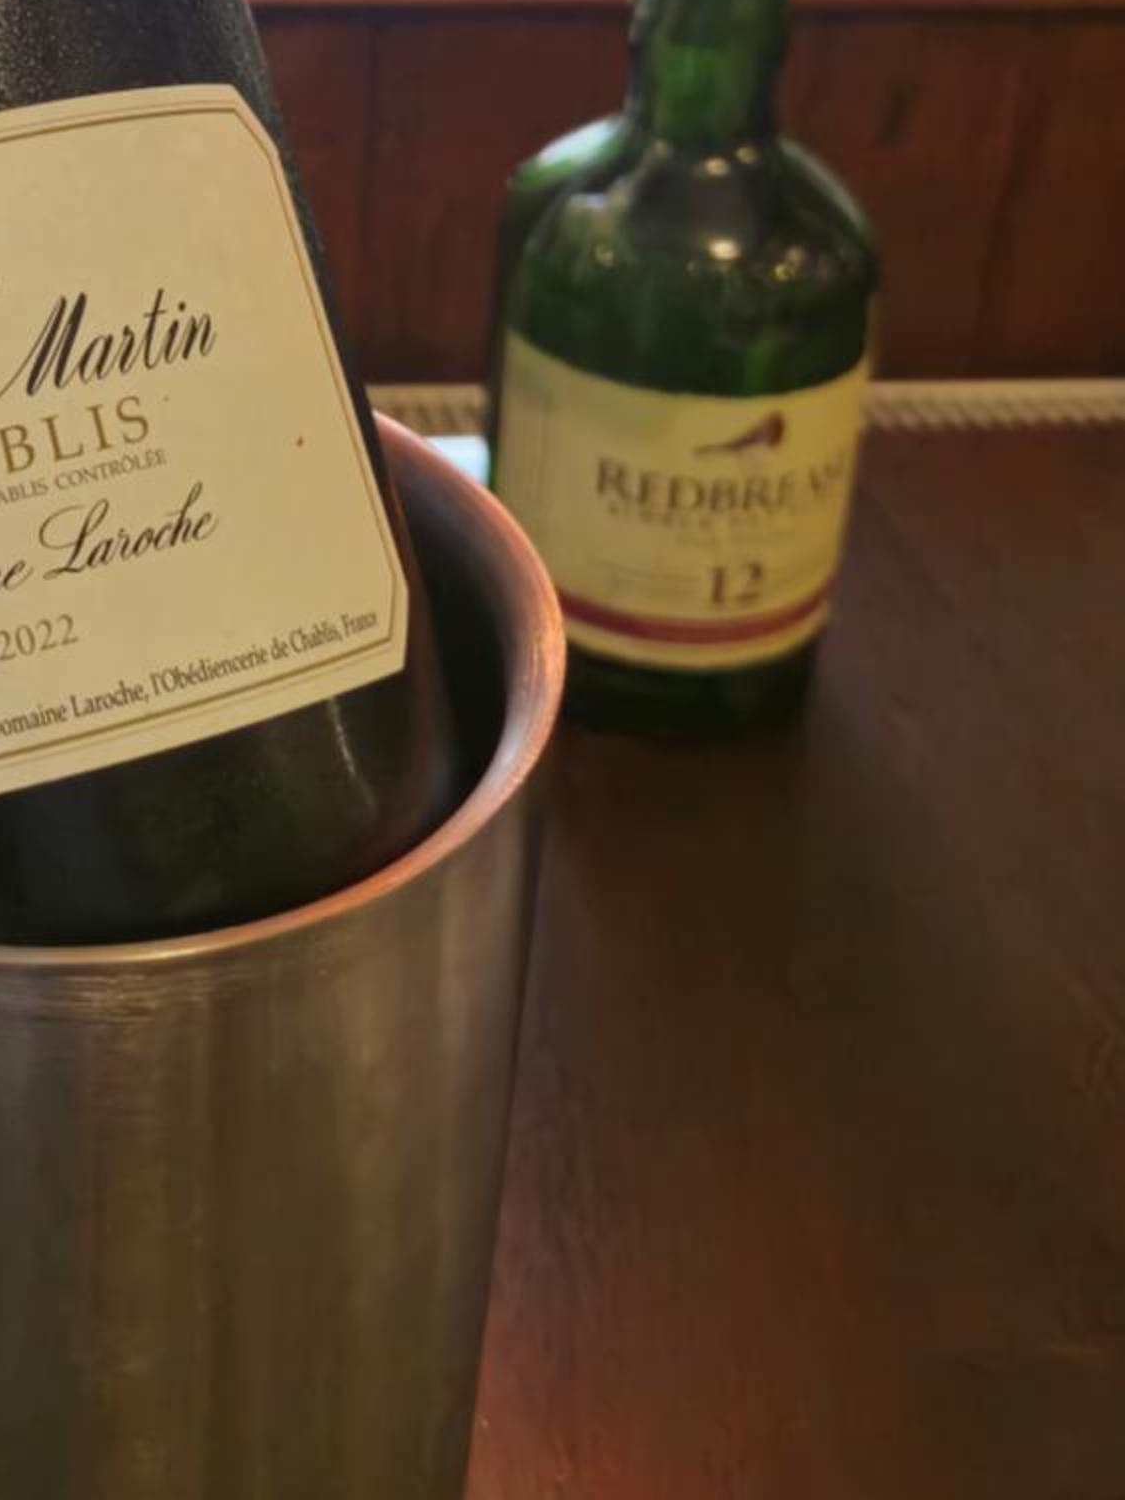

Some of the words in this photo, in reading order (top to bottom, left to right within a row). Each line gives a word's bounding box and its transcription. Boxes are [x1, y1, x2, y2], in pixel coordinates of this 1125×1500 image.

[38, 480, 220, 581] Laroche
[708, 558, 765, 608] 12
[70, 679, 150, 718] Laroche,
[270, 635, 289, 661] de
